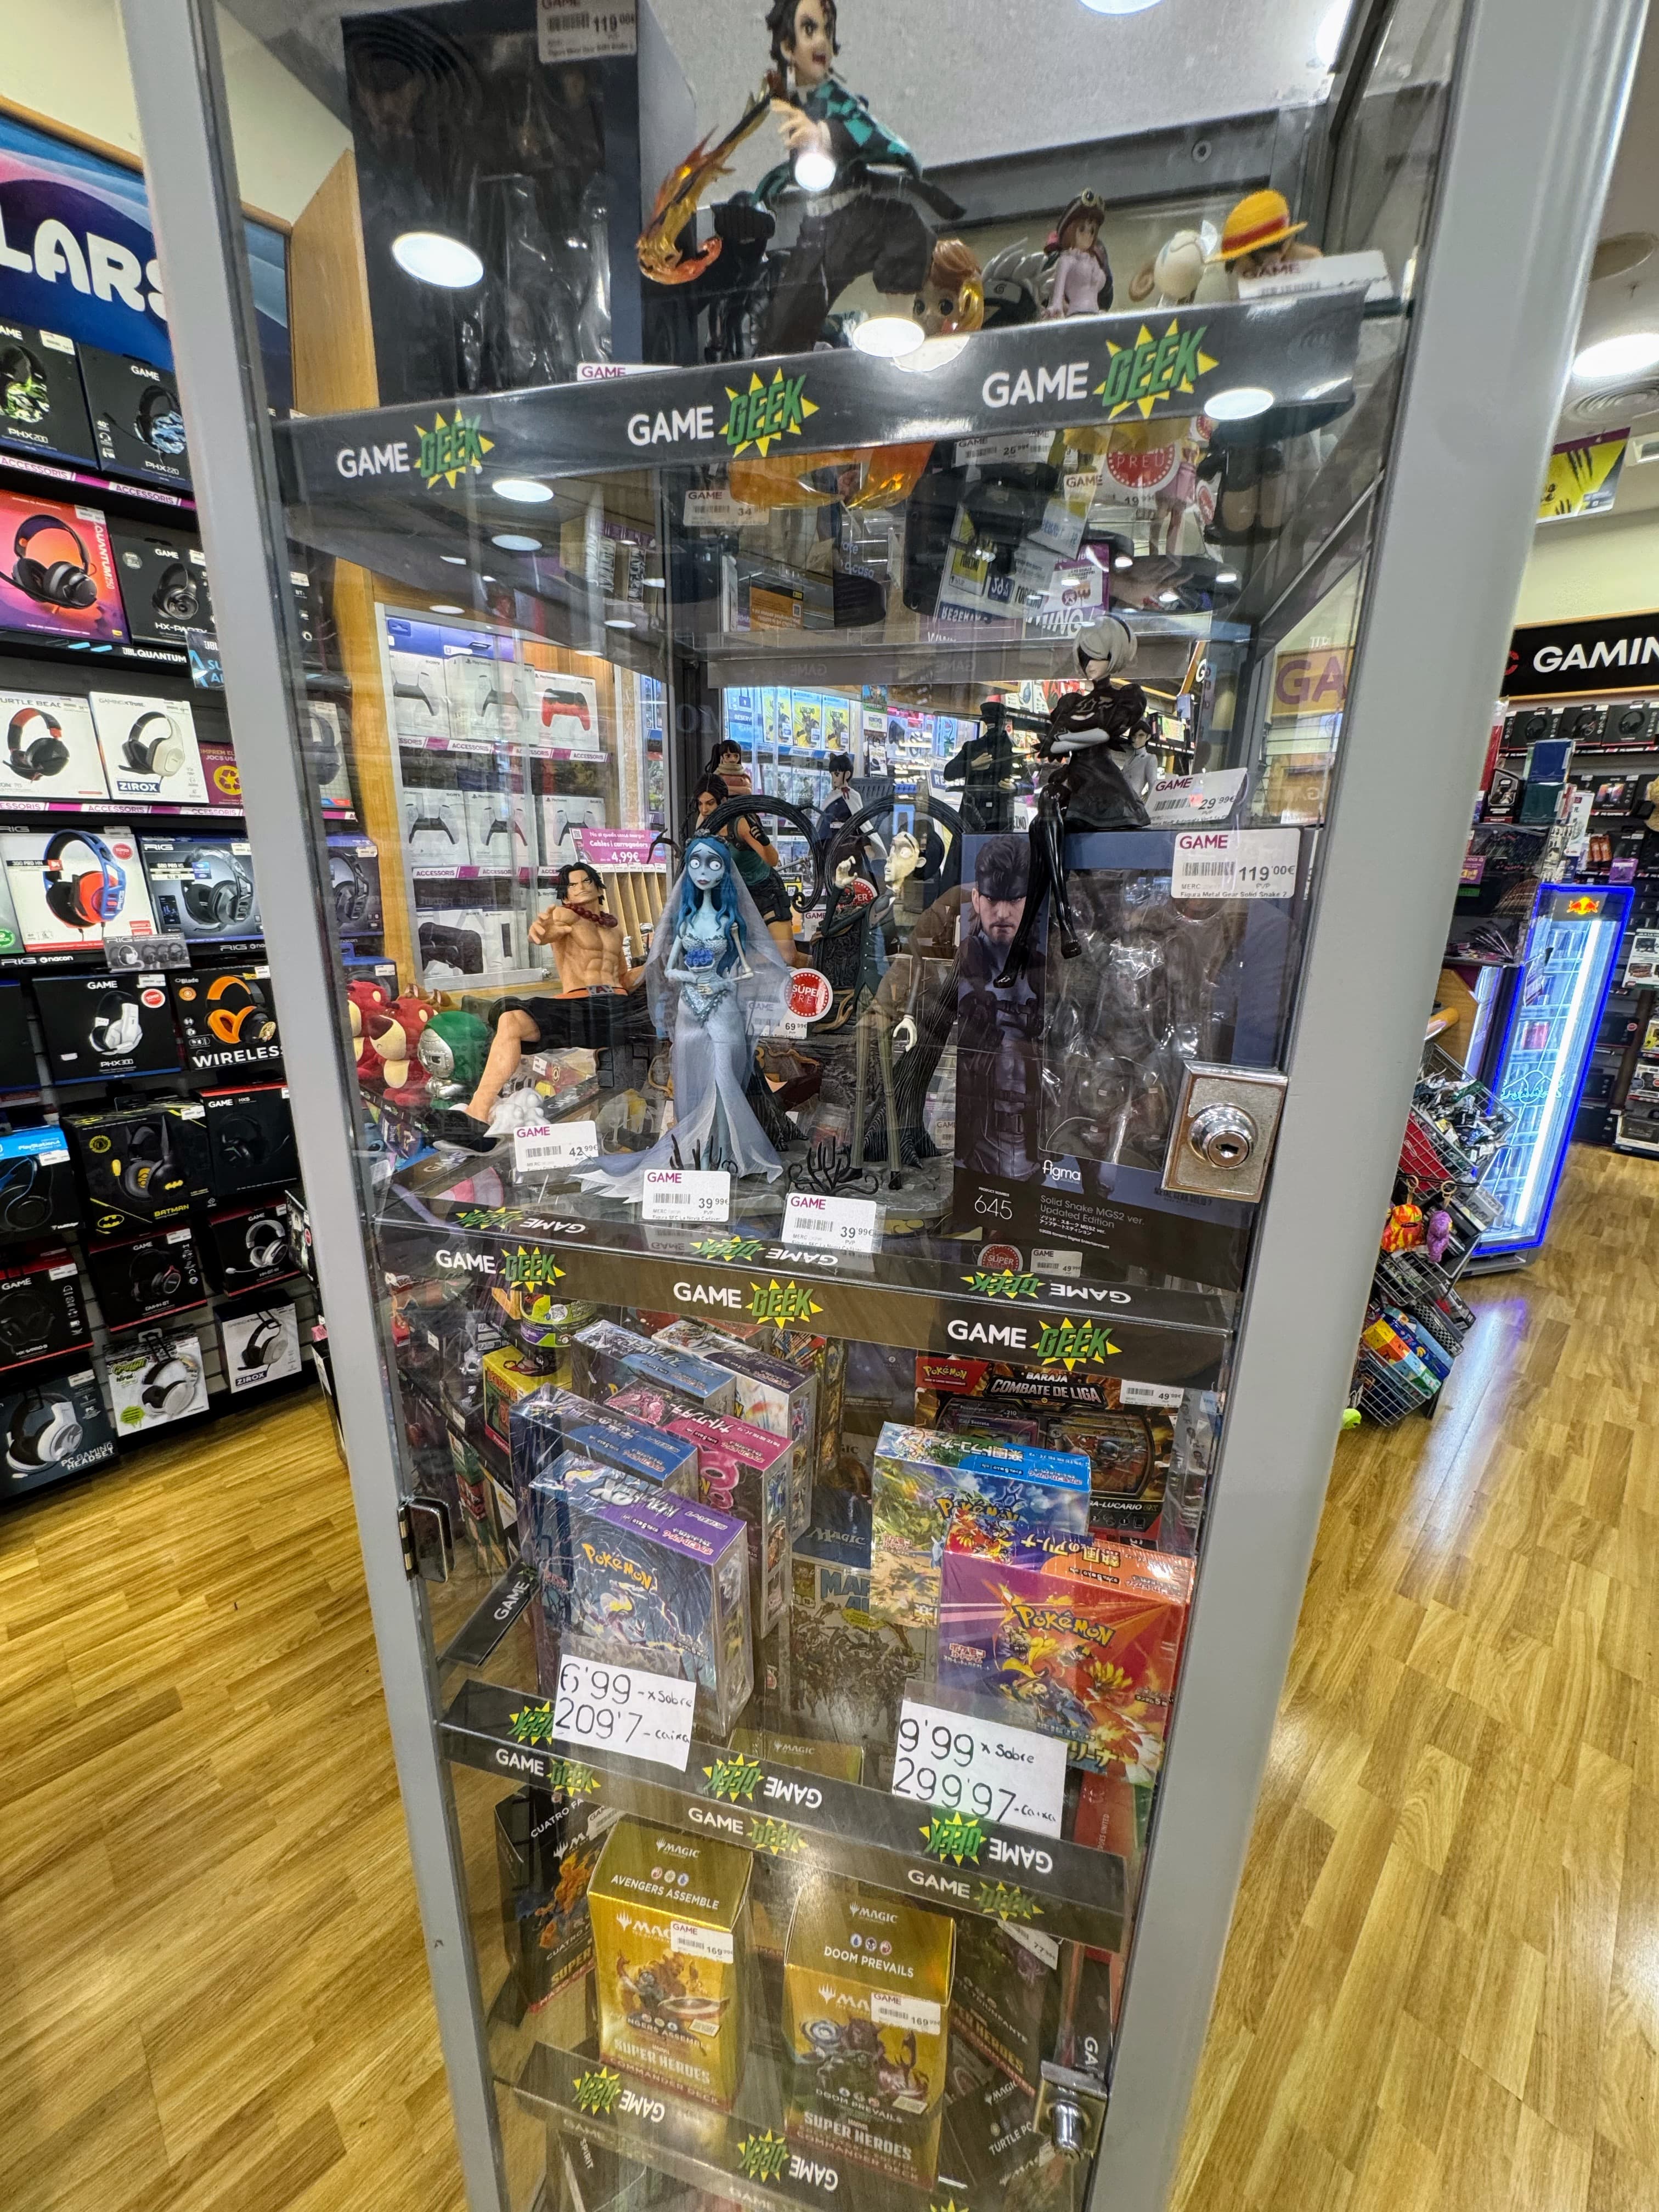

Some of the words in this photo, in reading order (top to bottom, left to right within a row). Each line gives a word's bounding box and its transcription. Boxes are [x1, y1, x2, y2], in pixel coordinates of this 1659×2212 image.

[131, 365, 160, 382] GAME
[983, 361, 1089, 408] GAME
[1102, 326, 1207, 407] GEEK
[627, 406, 714, 447] GAME
[727, 374, 806, 446] GEEK
[336, 442, 410, 478] GAME
[420, 414, 483, 479] GEEK
[1116, 453, 1165, 469] PREU
[1066, 475, 1103, 489] GAME
[116, 484, 174, 505] ACCESSORIS
[688, 492, 723, 500] GAME
[154, 549, 180, 560] GAME
[137, 647, 188, 663] QUANTUM
[119, 781, 160, 793] ZIROX
[1155, 777, 1194, 792] GAME
[88, 805, 145, 814] ACCESSORIS
[1180, 834, 1229, 850] GAME
[611, 851, 641, 865] 4,99€
[1, 957, 36, 966] RIG
[87, 981, 118, 990] GAME
[208, 1098, 233, 1108] GAME
[516, 1126, 551, 1139] GAME
[647, 1172, 682, 1184] GAME
[1042, 1159, 1081, 1181] figma
[154, 1204, 190, 1218] BATMAN
[698, 1197, 730, 1209] 39'99€
[790, 1195, 827, 1210] GAME
[974, 1194, 1013, 1221] 645
[1040, 1194, 1063, 1207] Solid
[1065, 1200, 1094, 1214] Snake
[1096, 1206, 1125, 1221] MGS2
[1127, 1215, 1146, 1226] ver.
[519, 1216, 588, 1235] GAME
[1040, 1204, 1080, 1221] Updated
[1082, 1214, 1115, 1229] Edition
[840, 1226, 874, 1238] 39'99€
[694, 1239, 764, 1259] GEEK
[765, 1248, 839, 1266] GAME
[436, 1249, 497, 1274] GAME
[505, 1254, 557, 1282] GEEK
[1, 1277, 32, 1291] GAME
[970, 1273, 1040, 1295] GEEK
[1049, 1282, 1132, 1305] GAME
[673, 1282, 742, 1310] GAME
[751, 1288, 815, 1317] GEEK
[947, 1319, 1028, 1350] GAME
[1036, 1327, 1114, 1358] GEEK
[236, 1372, 267, 1386] ZIROX
[1026, 1371, 1068, 1383] BARAJA
[991, 1378, 1051, 1397] COMBATE
[1052, 1385, 1069, 1398] DE
[1070, 1386, 1101, 1402] LIGA
[67, 1447, 115, 1470] HEADSET
[805, 1527, 867, 1546] MAGIC
[1020, 1533, 1121, 1568] 熱風のアリーナ
[493, 1580, 531, 1621] GAME
[555, 1696, 643, 1743] 209'7
[783, 1742, 815, 1756] MAGIC
[899, 1717, 975, 1768] 9'99
[995, 1743, 1035, 1764] Sobre
[495, 1748, 544, 1777] GAME
[707, 1763, 761, 1795] GEEK
[764, 1776, 822, 1809] GAME
[895, 1757, 1018, 1824] 299'97
[531, 1805, 570, 1838] CUATRO
[689, 1808, 744, 1835] GAME
[663, 1839, 701, 1859] MAGIC
[928, 1825, 986, 1858] GEEK
[988, 1837, 1053, 1874] GAME
[611, 1874, 664, 1897] AVENGERS
[665, 1885, 720, 1911] ASSEMBLE
[907, 1870, 971, 1899] GAME
[857, 1906, 898, 1925] MAGIC
[673, 1922, 698, 1936] GAME
[546, 1931, 583, 1961] CUATRO
[551, 1949, 591, 1987] SUPER
[824, 1945, 859, 1968] DOOM
[860, 1954, 915, 1979] PREVAILS
[873, 1993, 903, 2007] GAME
[614, 2039, 656, 2064] SUPER
[663, 2052, 710, 2085] HEROES
[618, 2090, 666, 2123] GAME
[804, 2111, 851, 2141] SUPER
[854, 2130, 912, 2162] HEROES
[989, 2130, 1019, 2157] TURTLE
[579, 2139, 594, 2170] SPIRIT
[788, 2154, 839, 2191] GAME
